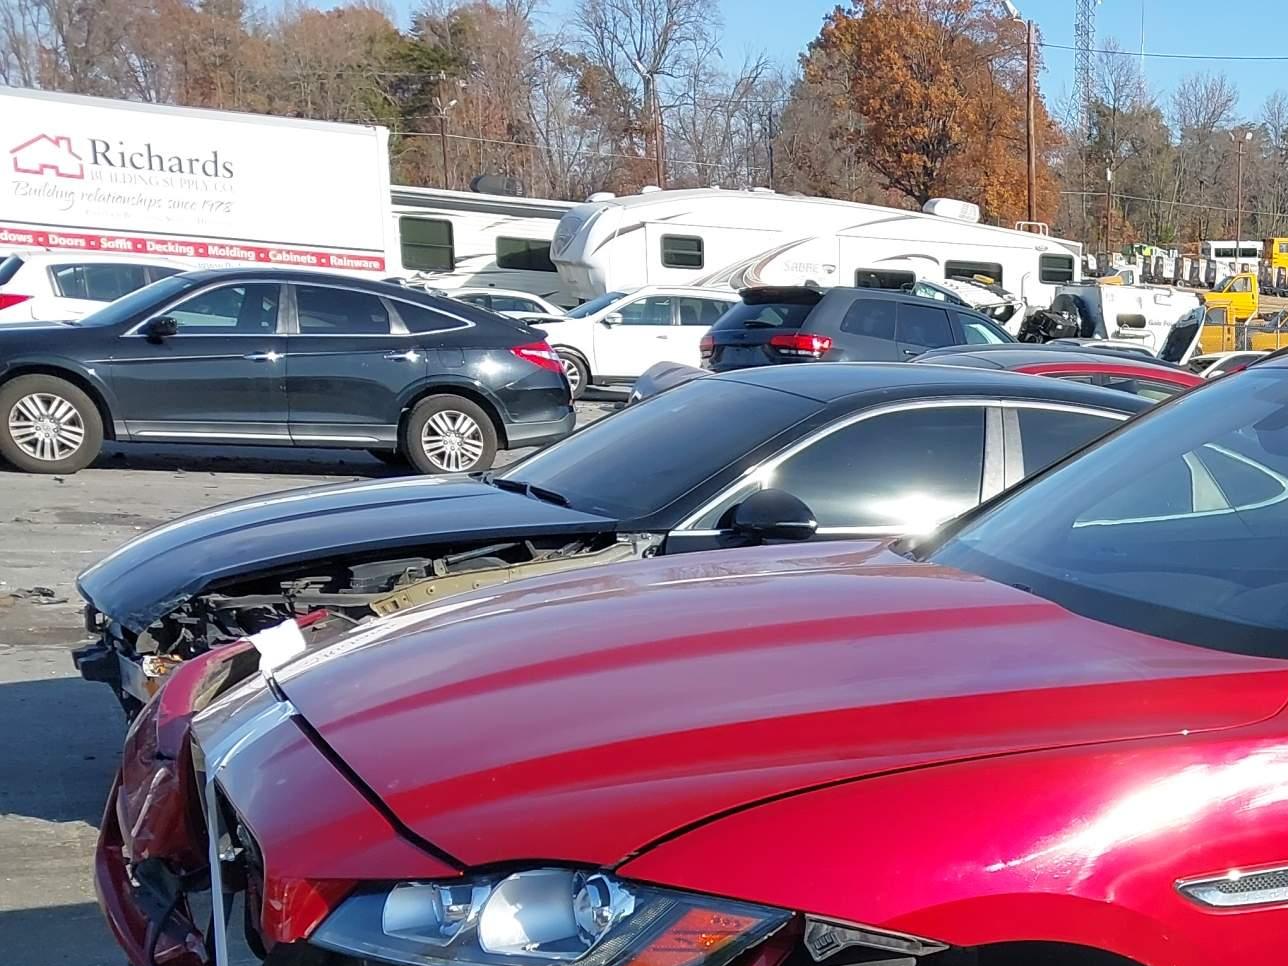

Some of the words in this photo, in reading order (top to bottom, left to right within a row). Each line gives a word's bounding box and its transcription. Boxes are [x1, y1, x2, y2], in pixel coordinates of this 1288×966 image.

[88, 137, 234, 179] Richards
[48, 234, 86, 247] Doors
[100, 237, 133, 250] Soffit
[146, 242, 195, 256] Decking
[208, 246, 256, 261] Molding
[268, 250, 317, 264] Cabinets
[330, 255, 380, 269] Rainware
